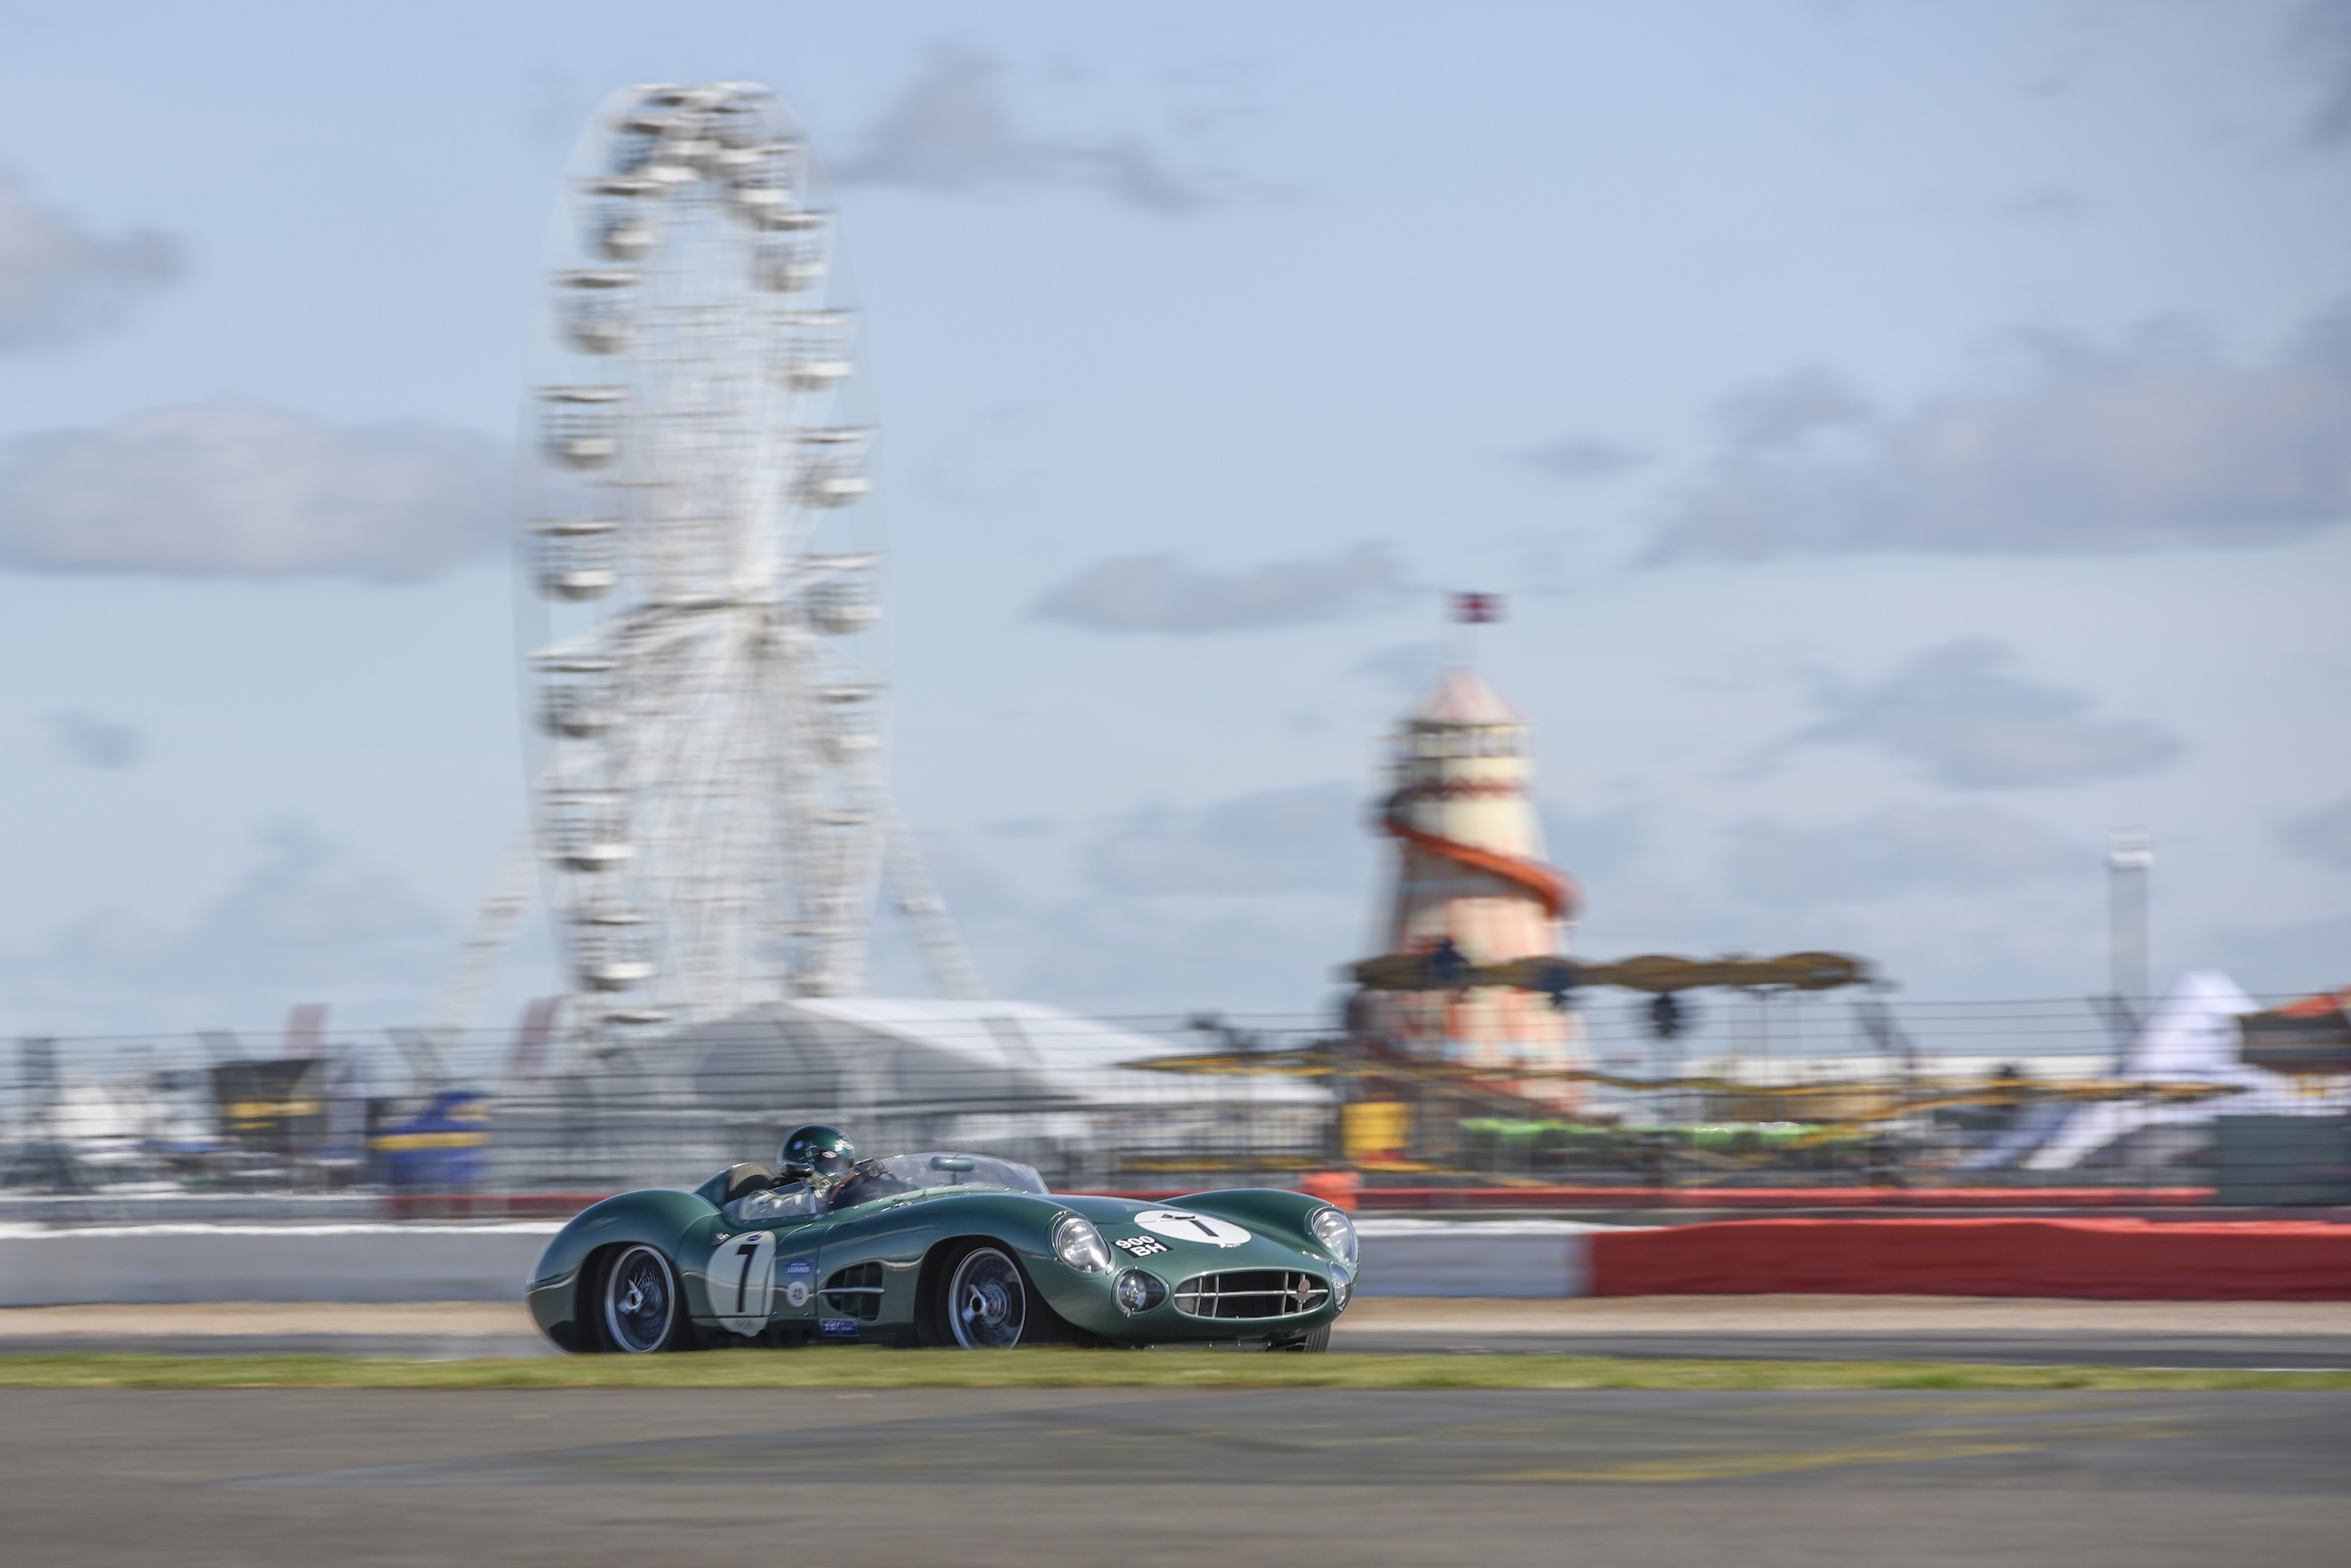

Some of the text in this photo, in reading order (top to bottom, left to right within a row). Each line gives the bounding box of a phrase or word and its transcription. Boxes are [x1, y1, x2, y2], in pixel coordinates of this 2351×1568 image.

[1160, 1213, 1220, 1238] 7
[1115, 1235, 1156, 1249] 900
[1130, 1242, 1167, 1257] BH
[735, 1244, 759, 1313] 7
